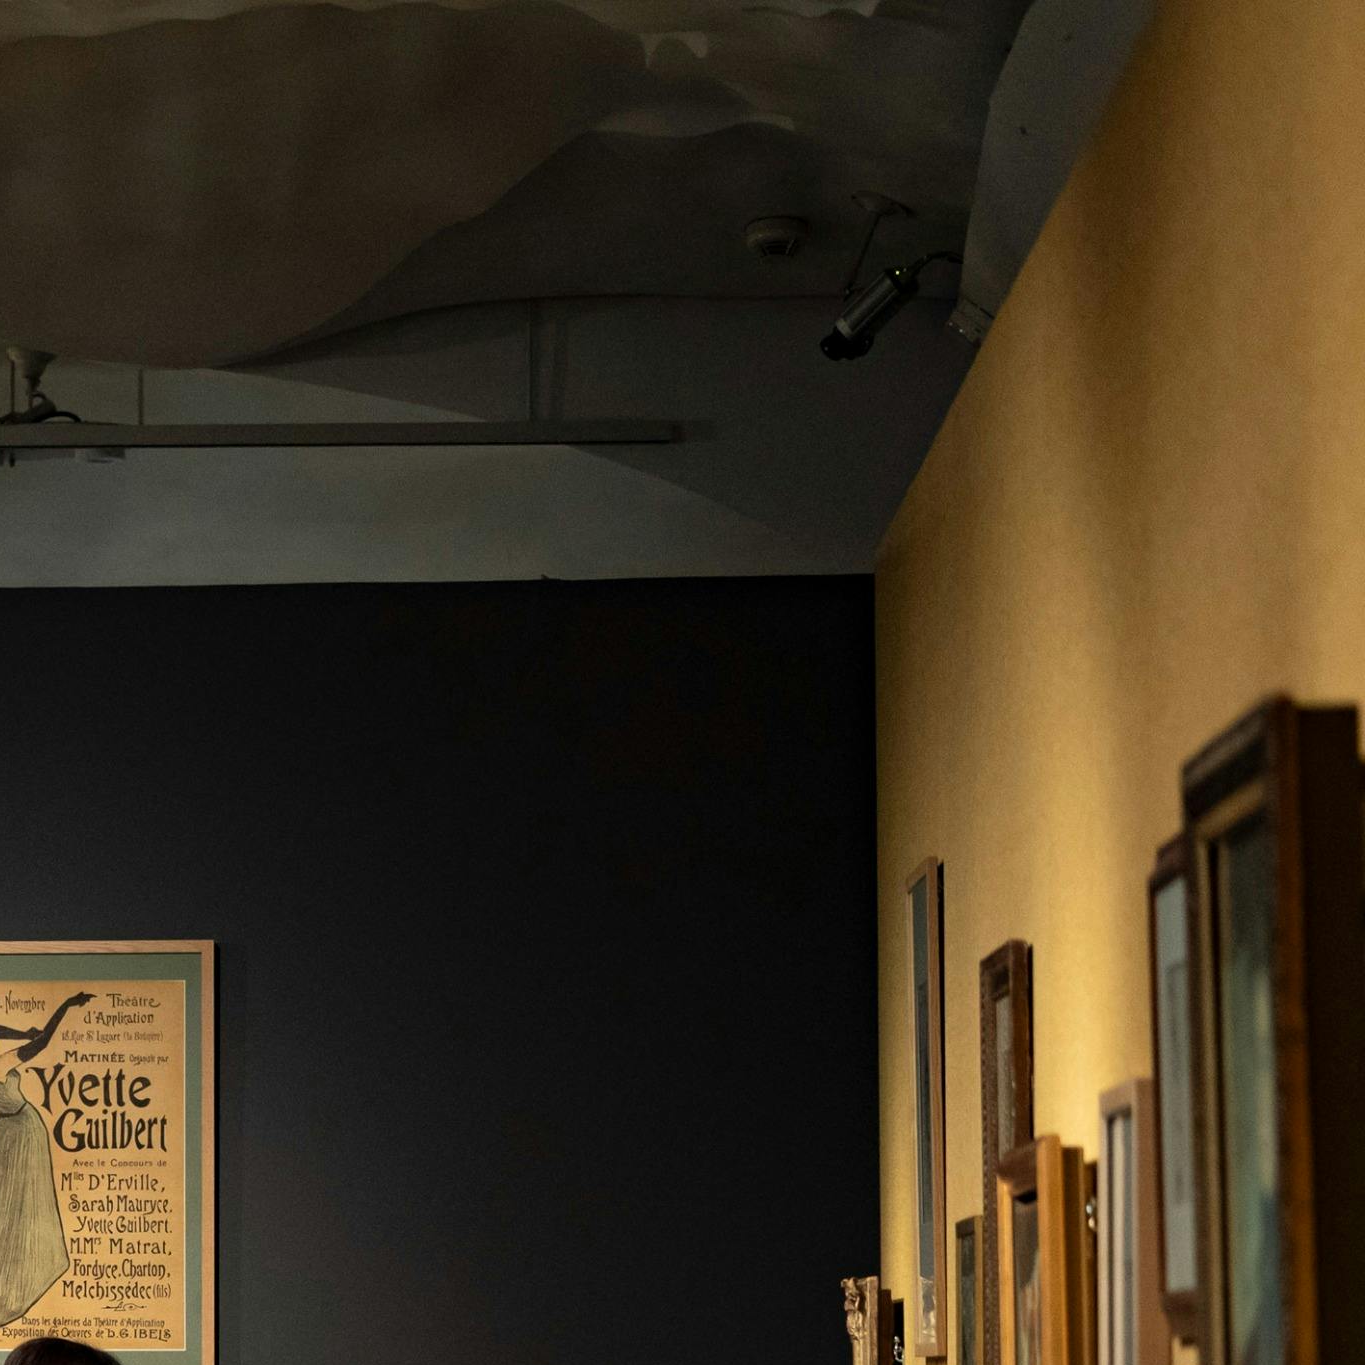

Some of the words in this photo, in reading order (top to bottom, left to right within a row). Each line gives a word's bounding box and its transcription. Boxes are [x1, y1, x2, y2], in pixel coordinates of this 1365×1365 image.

[5, 990, 46, 1014] Novembre
[84, 1011, 155, 1027] d'Application
[64, 1050, 125, 1063] MATINÉE
[25, 1062, 151, 1115] Yvette
[53, 1108, 167, 1152] Guilbert
[72, 1159, 94, 1167] Avec
[97, 1159, 106, 1167] le
[110, 1159, 153, 1167] Concours
[157, 1159, 167, 1167] de
[88, 1173, 165, 1192] D'Erville,
[69, 1194, 114, 1216] Sarah
[73, 1216, 113, 1234] Yvette
[109, 1238, 172, 1256] Matrat,
[22, 1317, 40, 1326] Dans
[42, 1316, 51, 1326] les
[2, 1328, 45, 1339] Exposition
[134, 1328, 172, 1342] IBELS
